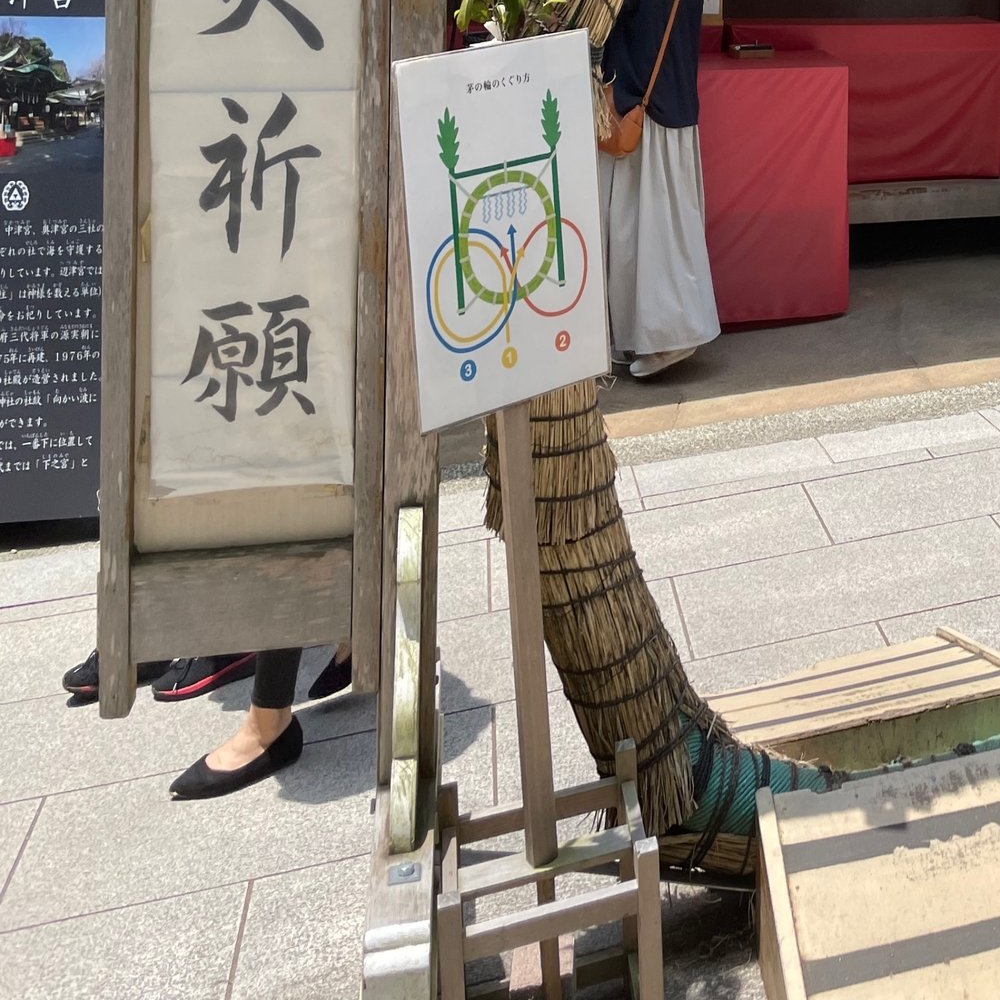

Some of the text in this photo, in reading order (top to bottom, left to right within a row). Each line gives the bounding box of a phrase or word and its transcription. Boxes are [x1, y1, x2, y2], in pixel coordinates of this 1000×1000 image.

[466, 72, 530, 94] 茅の輪のくぐり方
[0, 371, 102, 386] 社殿が造営されました。
